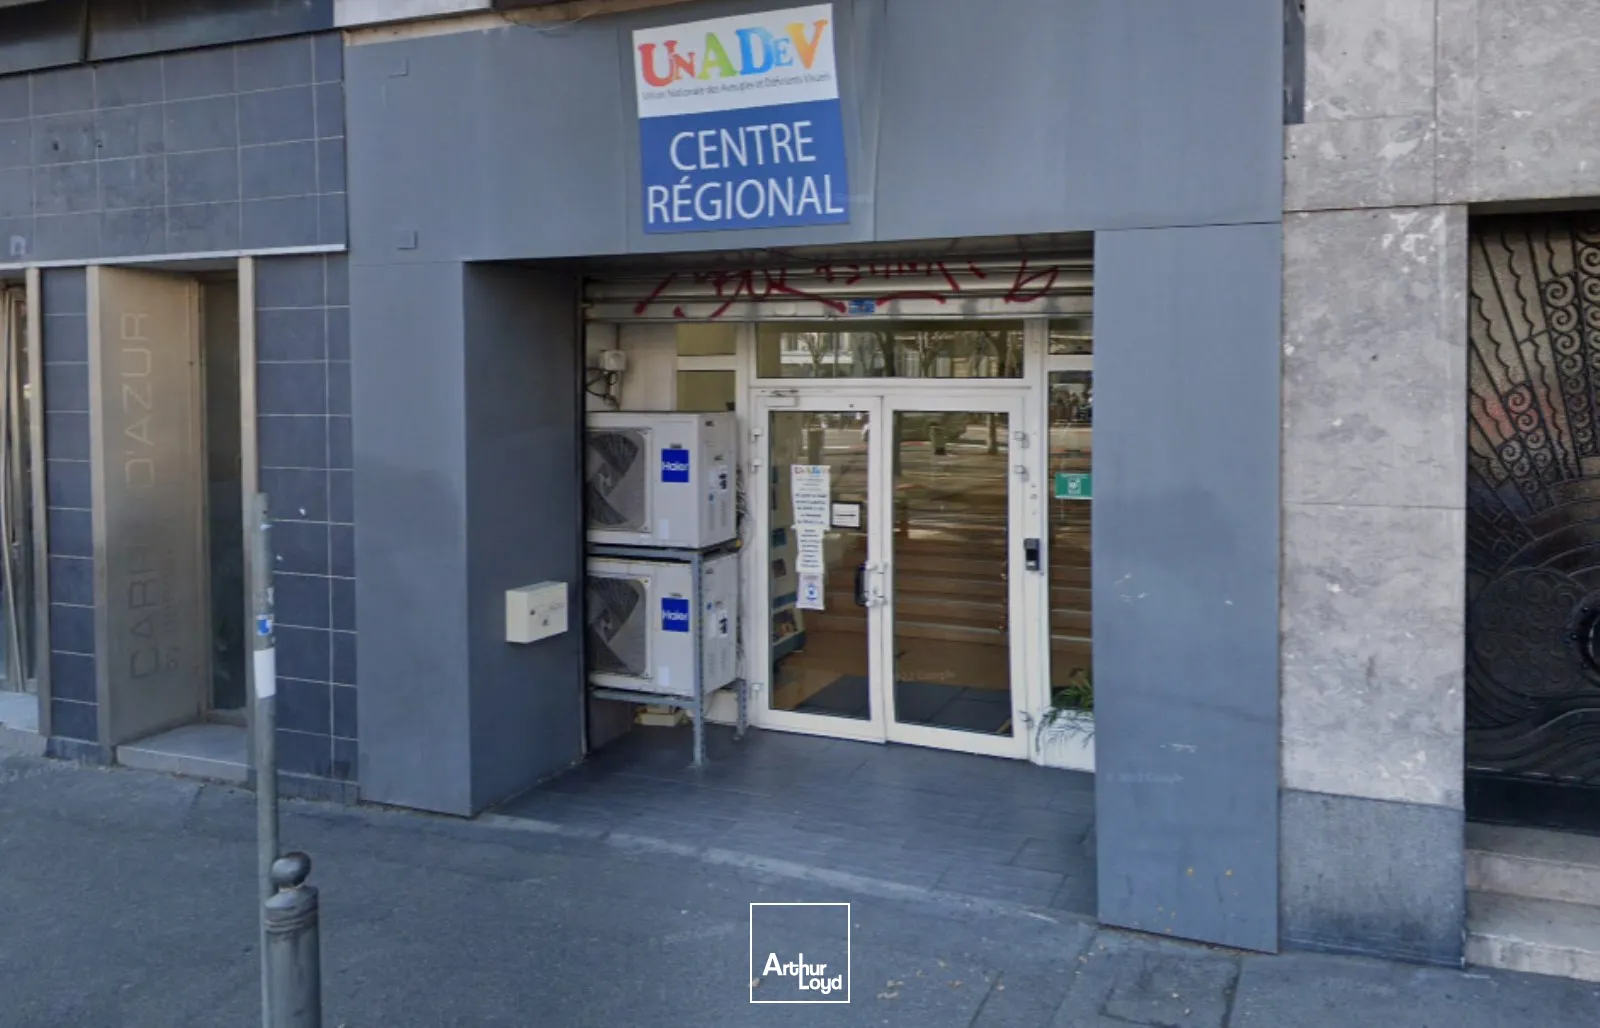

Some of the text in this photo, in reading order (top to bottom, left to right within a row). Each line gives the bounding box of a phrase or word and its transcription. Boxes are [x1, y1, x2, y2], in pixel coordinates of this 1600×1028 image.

[669, 120, 817, 171] CENTRE
[647, 174, 845, 224] RÉGIONAL
[120, 312, 154, 489] D'AZUR
[661, 460, 689, 472] Haier
[661, 609, 689, 621] Haier
